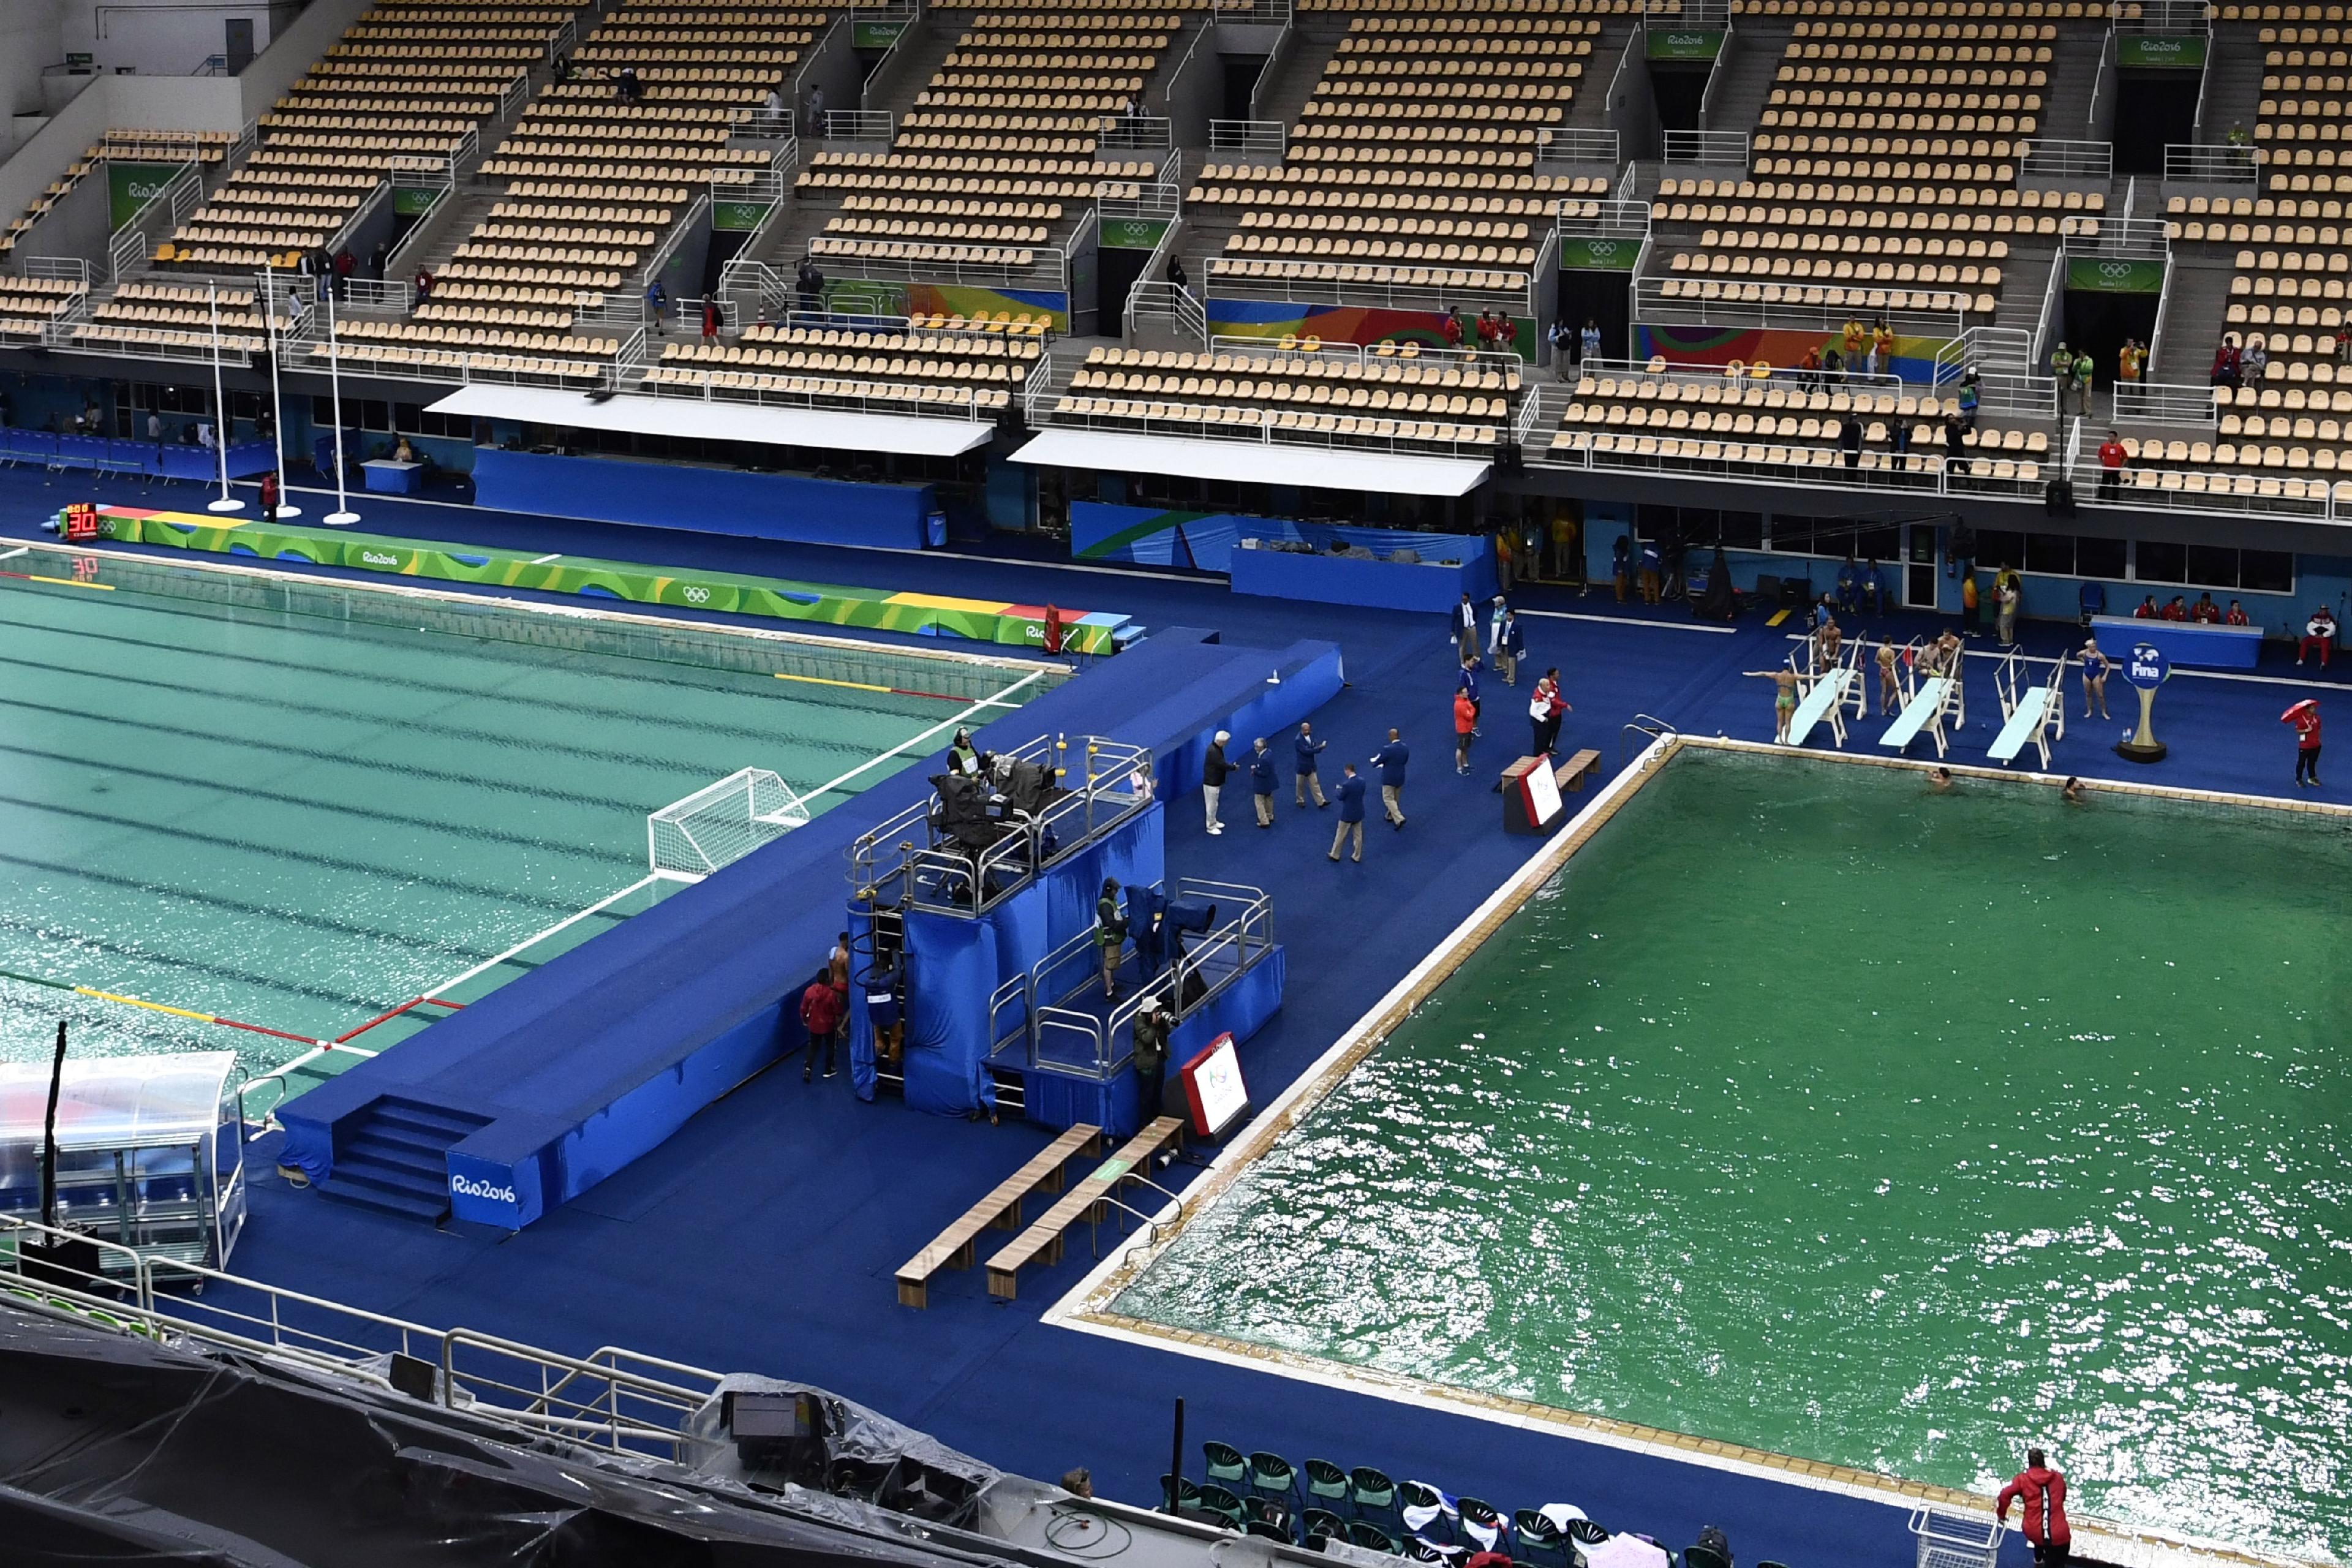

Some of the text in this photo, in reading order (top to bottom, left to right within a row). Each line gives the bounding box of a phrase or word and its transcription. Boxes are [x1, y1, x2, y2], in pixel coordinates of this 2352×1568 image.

[1667, 35, 1703, 45] Rio2016
[2141, 40, 2180, 51] Rio2016
[69, 513, 96, 532] 30
[363, 551, 398, 565] Rio2016
[1026, 625, 1069, 642] Rio16
[453, 1174, 515, 1202] Rio2016
